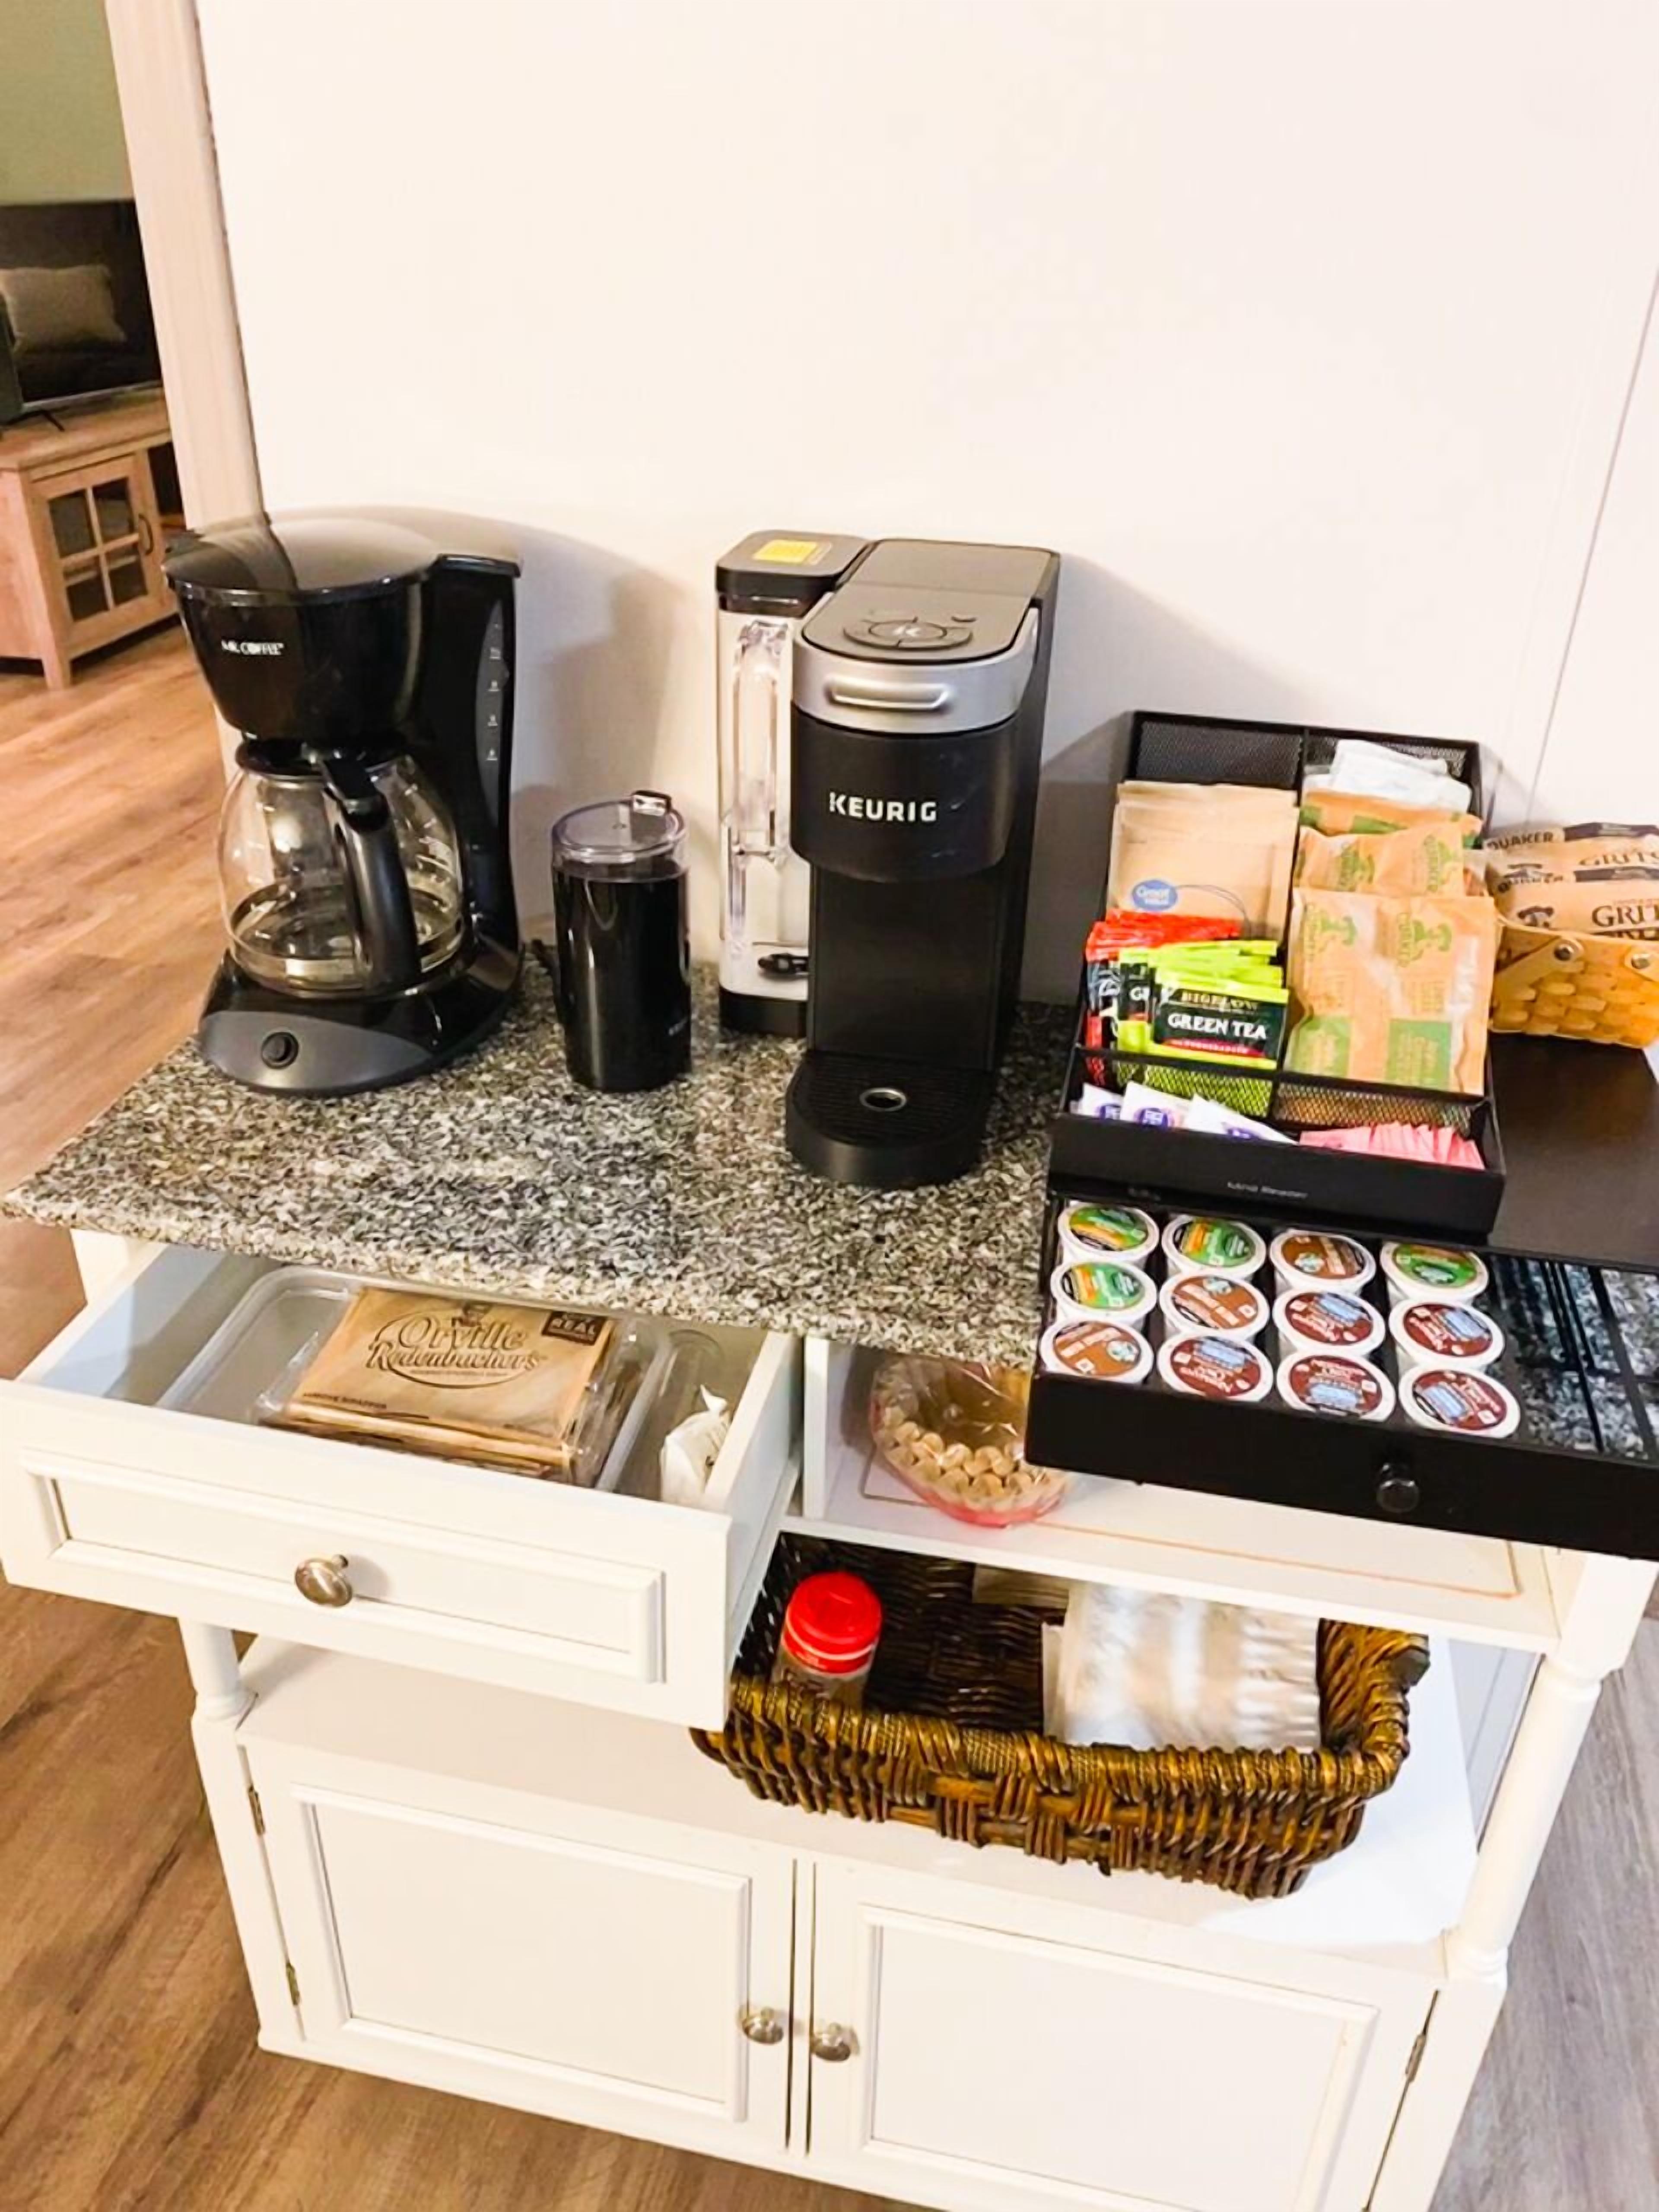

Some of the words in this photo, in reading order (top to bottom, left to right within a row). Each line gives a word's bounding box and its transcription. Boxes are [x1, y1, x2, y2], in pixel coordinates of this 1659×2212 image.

[829, 791, 937, 822] KEURIG
[1168, 1013, 1229, 1035] GREEN
[1232, 1020, 1267, 1040] TEA
[399, 1316, 527, 1350] Orville
